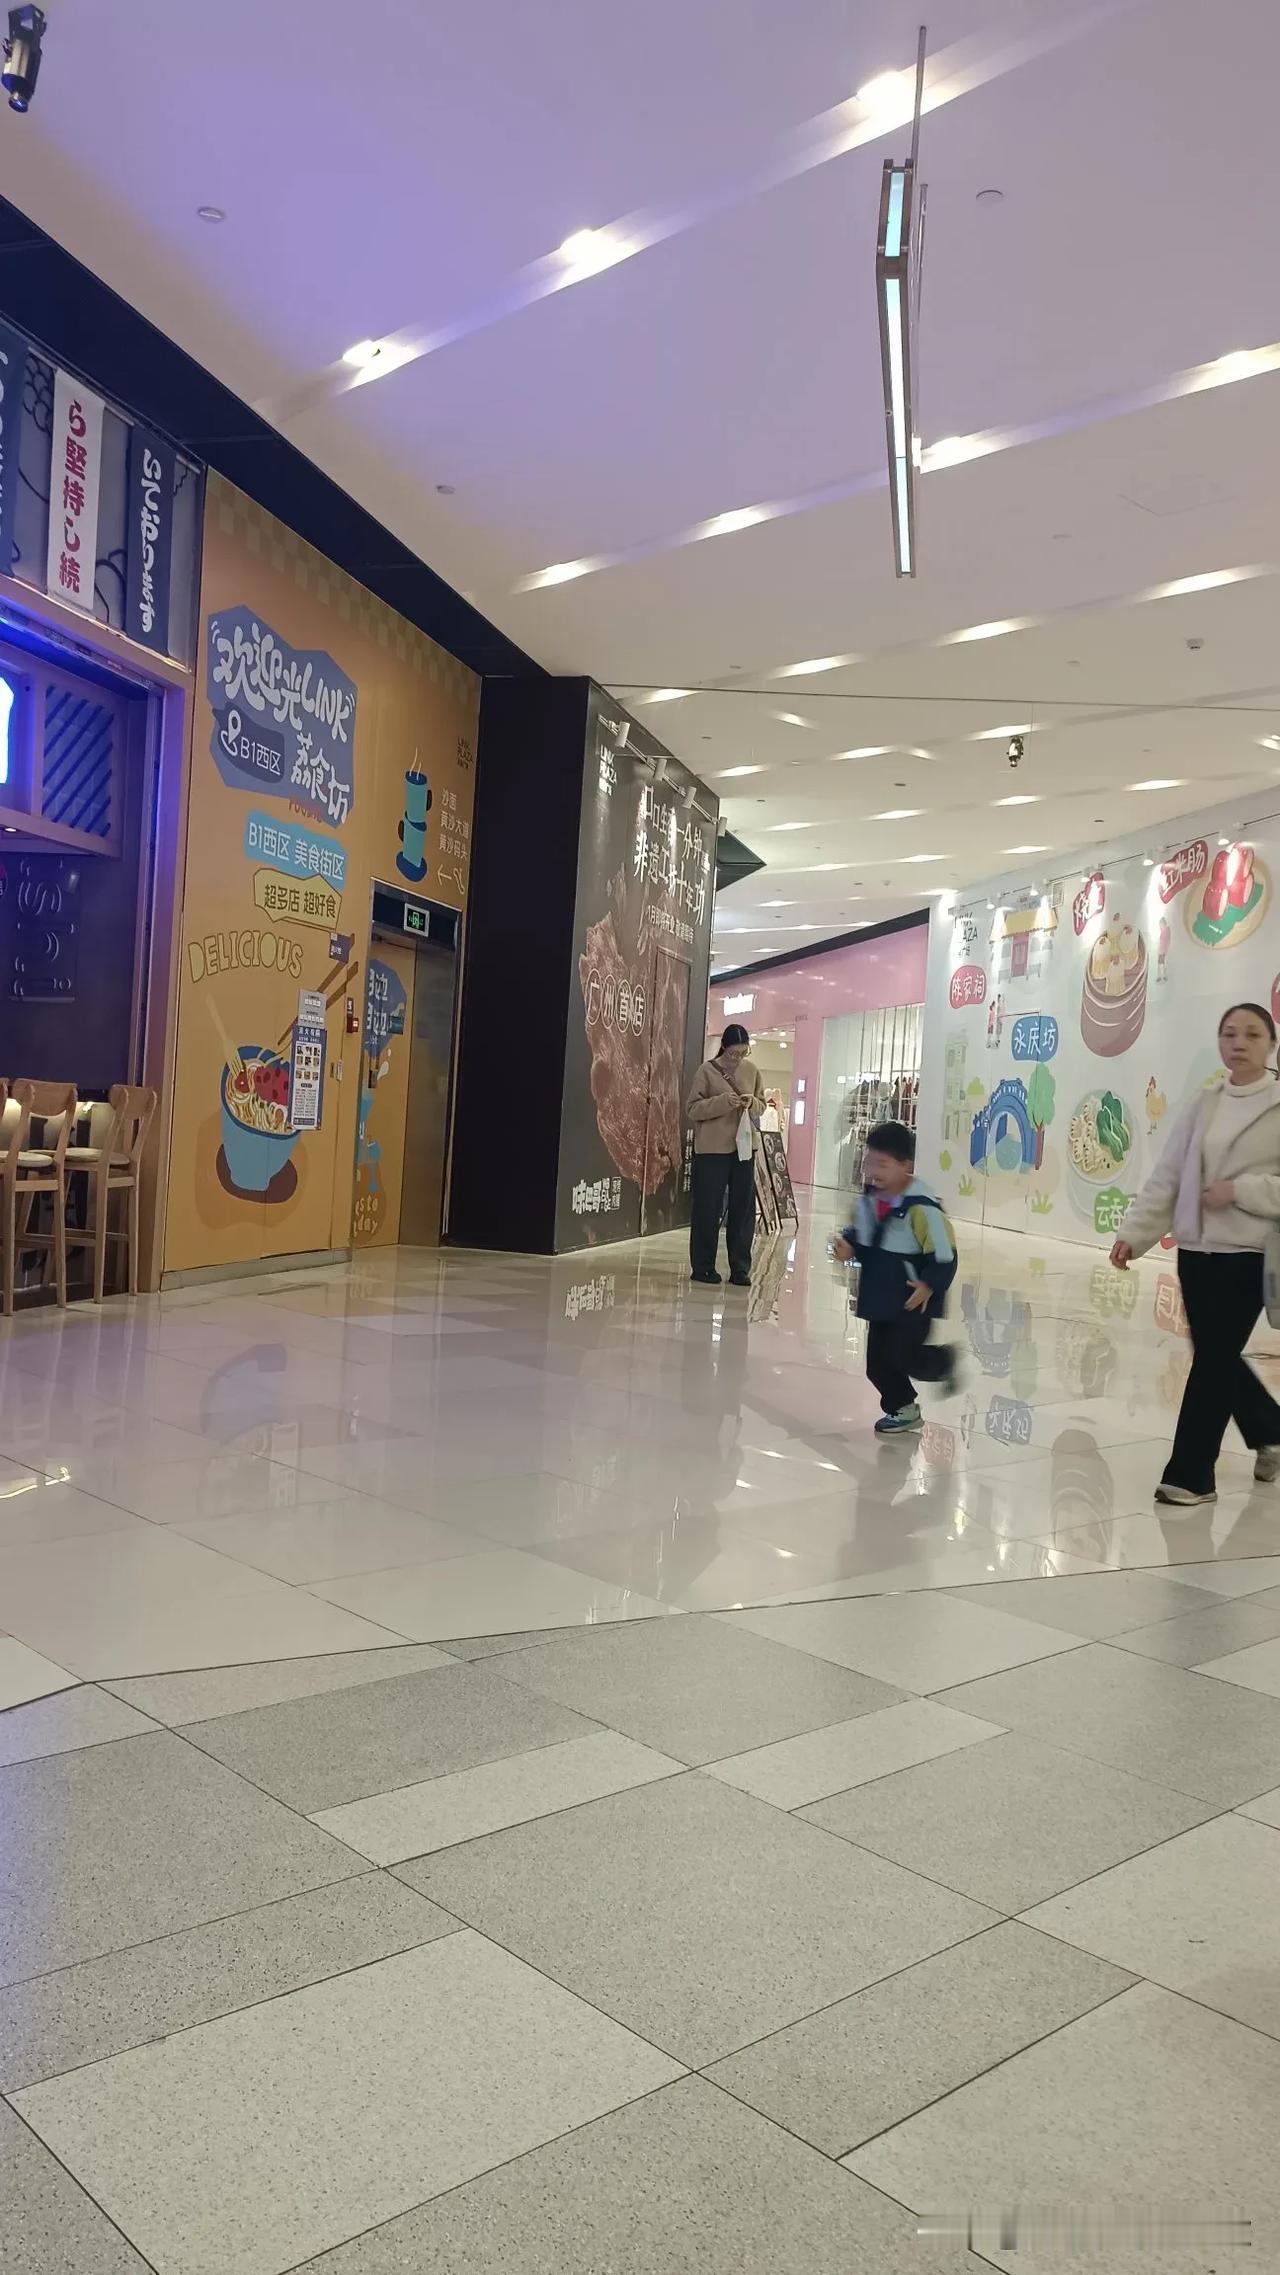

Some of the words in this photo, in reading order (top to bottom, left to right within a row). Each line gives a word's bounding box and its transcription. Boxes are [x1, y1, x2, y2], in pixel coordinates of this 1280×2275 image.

[240, 737, 282, 776] B1西区
[248, 822, 291, 861] B1西区
[294, 838, 345, 881] 美食街区
[633, 829, 706, 926] 非遗工坊十年功
[264, 884, 300, 913] 超多店
[303, 890, 337, 918] 超好食
[188, 930, 304, 983] DELICIOUS
[587, 972, 645, 1031] 广州首店
[1013, 1021, 1056, 1055] 永庆坊
